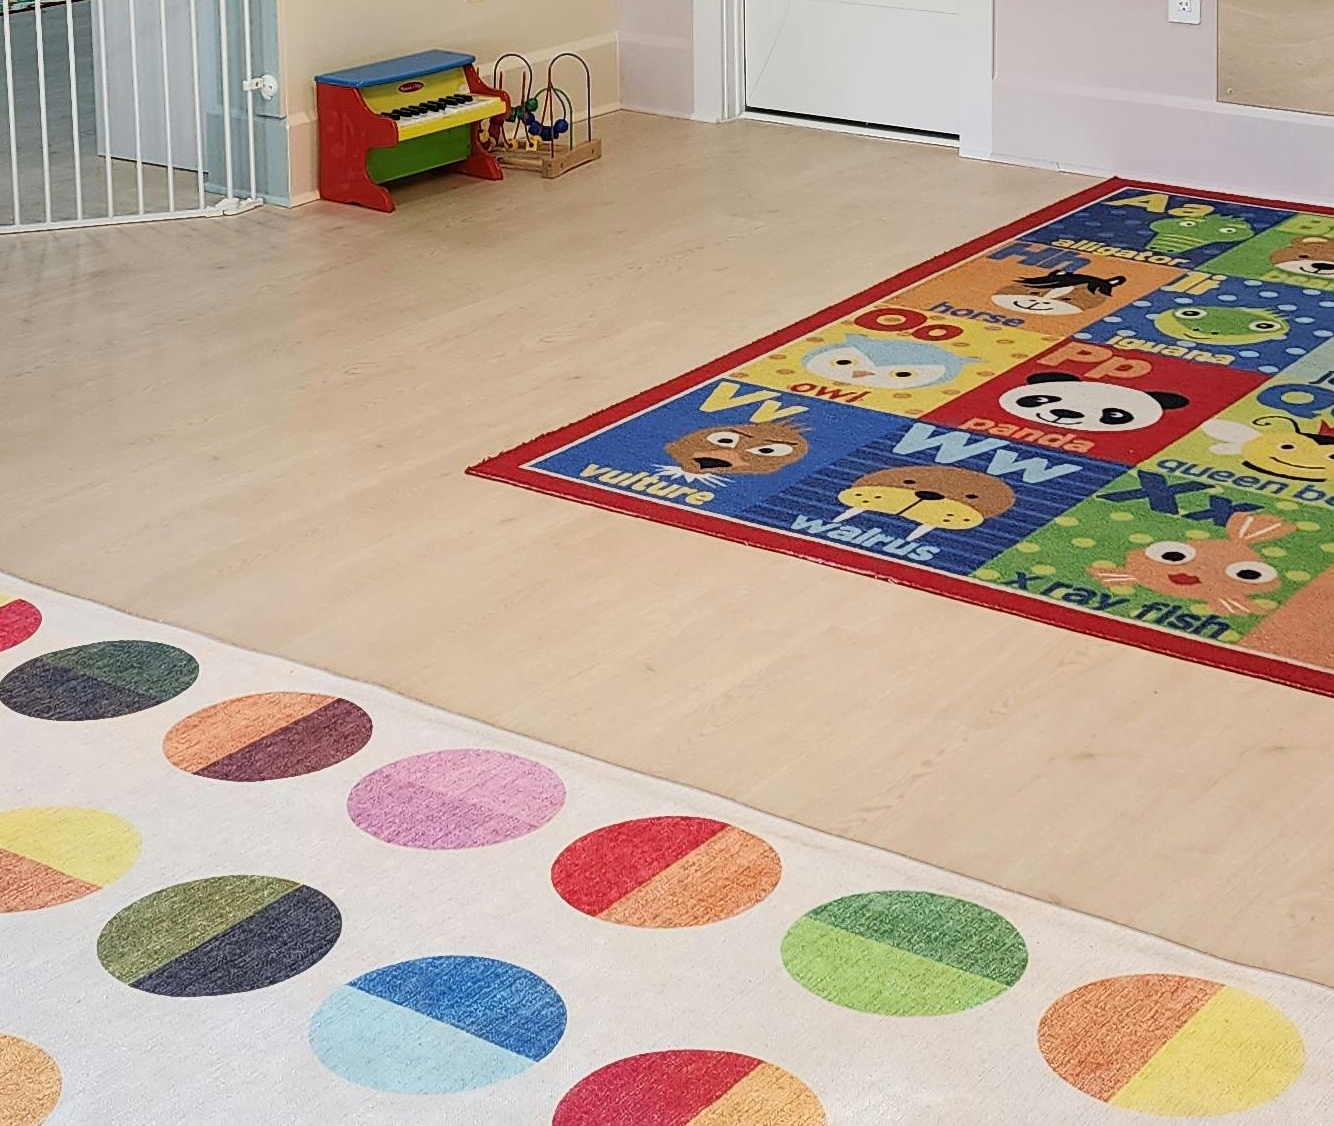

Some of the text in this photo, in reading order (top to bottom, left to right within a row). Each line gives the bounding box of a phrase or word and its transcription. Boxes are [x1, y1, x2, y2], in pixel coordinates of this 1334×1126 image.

[1101, 193, 1216, 219] Aa
[1051, 235, 1190, 270] alligator
[853, 306, 965, 342] Oo
[928, 300, 1027, 328] horse
[1036, 342, 1154, 379] Pp
[1108, 336, 1235, 366] iguana
[699, 379, 810, 424] Vv
[789, 382, 872, 403] owl
[891, 421, 1083, 484] Ww
[958, 417, 1097, 454] panda
[580, 463, 715, 505] vulture
[1156, 455, 1297, 497] queen
[1094, 469, 1266, 525] Xx
[790, 514, 943, 563] walrus
[1041, 580, 1118, 613] ray
[1129, 596, 1234, 641] fish
